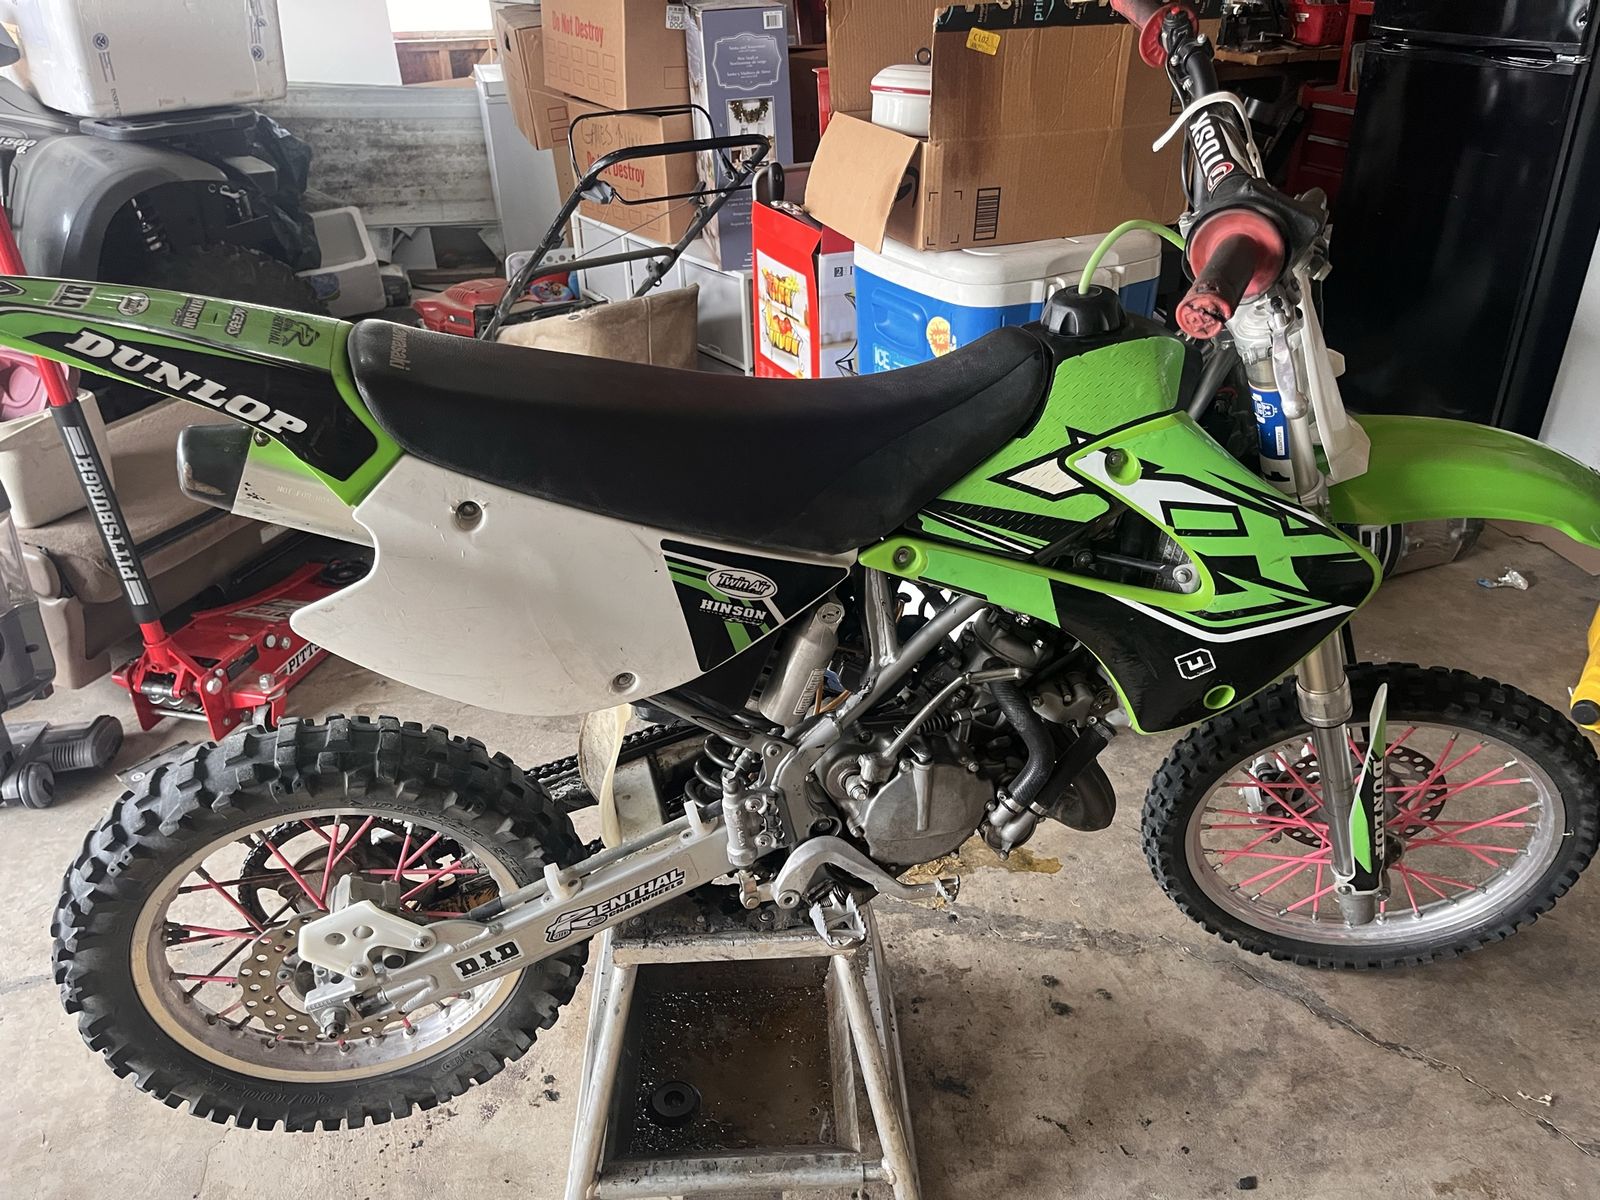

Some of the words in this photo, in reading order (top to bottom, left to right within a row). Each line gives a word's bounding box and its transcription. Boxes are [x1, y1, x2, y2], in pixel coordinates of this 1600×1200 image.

[552, 11, 560, 31] Do
[562, 13, 573, 35] Not
[575, 16, 604, 48] Destroy
[1189, 111, 1224, 177] TUSK
[614, 162, 645, 188] Destroy
[64, 329, 308, 435] DUNLOP
[74, 456, 139, 581] PITTSBURGH
[719, 573, 750, 590] Twin
[748, 580, 771, 594] Air
[700, 599, 767, 620] HINSON
[1372, 758, 1385, 861] DUNLOP
[545, 868, 685, 943] RENTHAL
[609, 880, 684, 918] CHAINWHEELS
[456, 942, 520, 977] D.I.D
